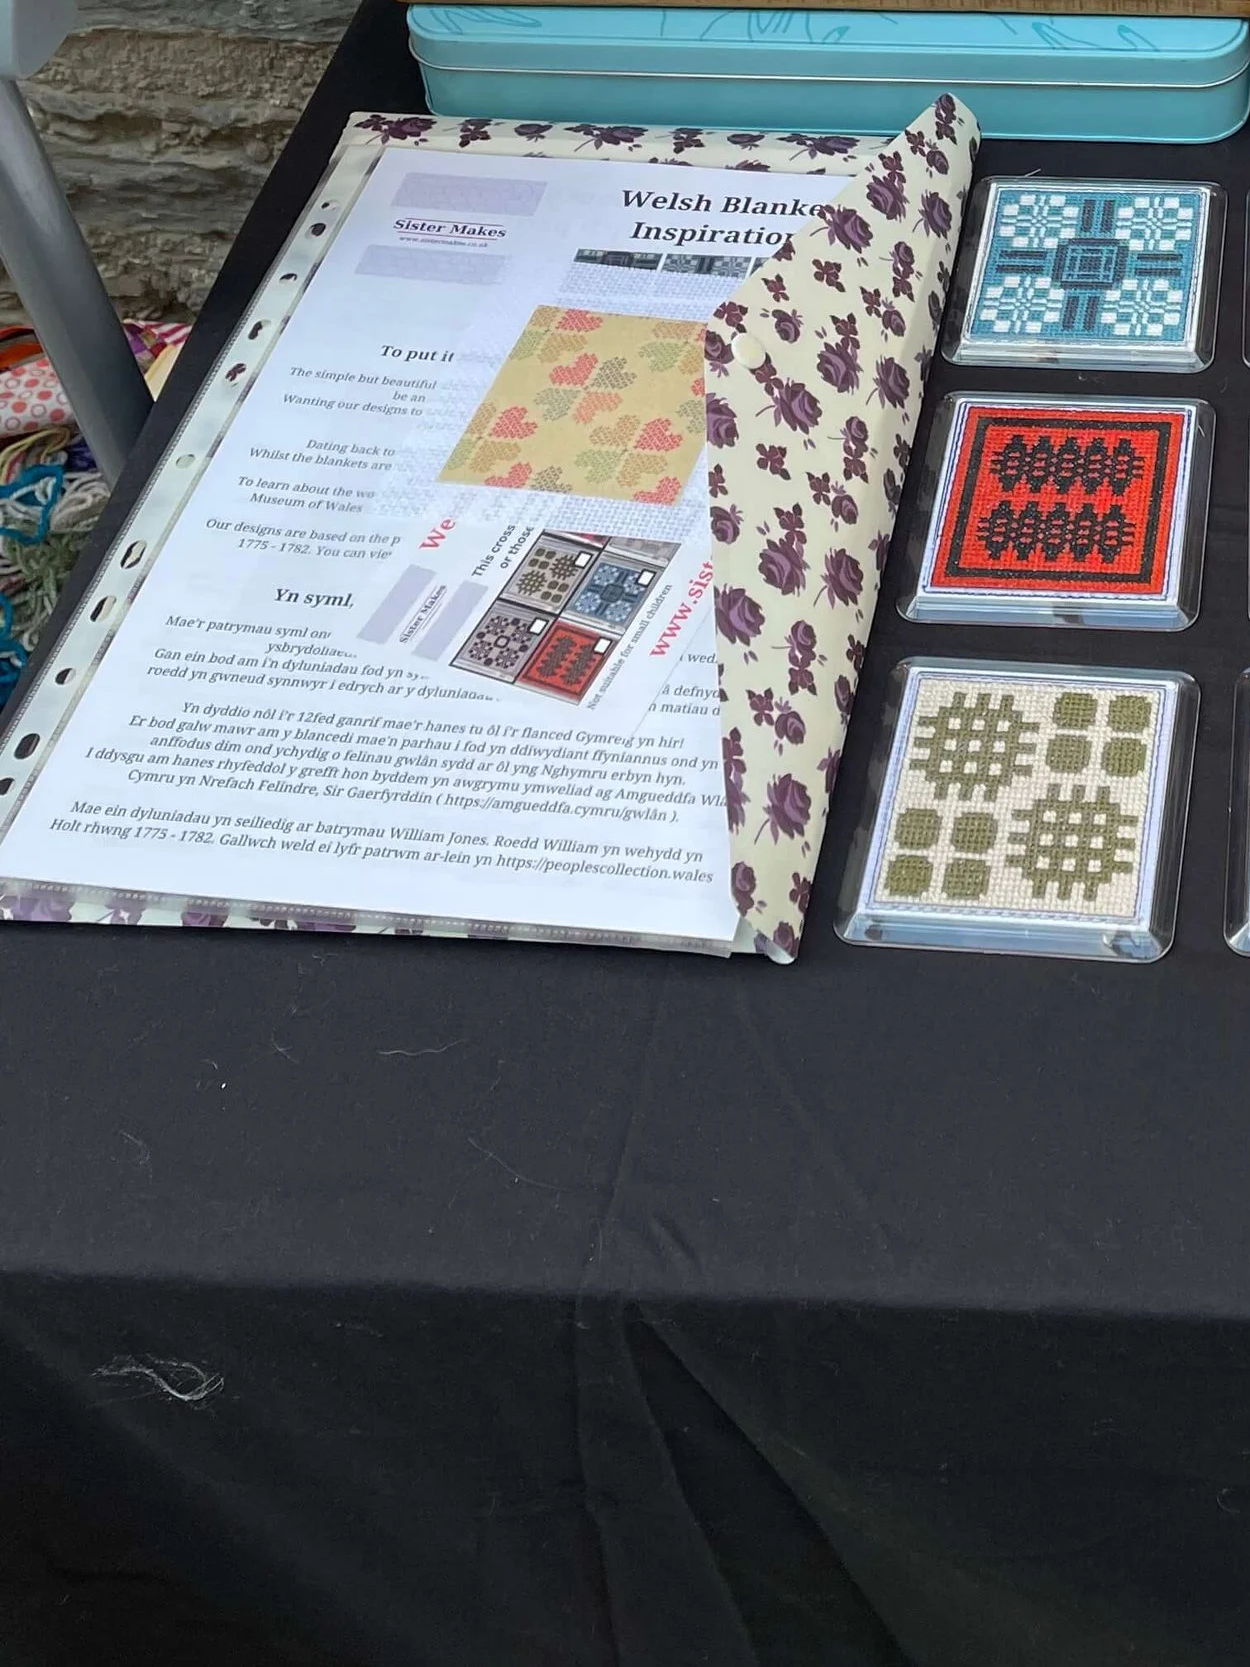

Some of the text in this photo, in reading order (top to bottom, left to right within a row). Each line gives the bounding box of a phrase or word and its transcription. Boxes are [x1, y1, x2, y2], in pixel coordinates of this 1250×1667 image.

[621, 189, 823, 216] Welsh Blanke
[393, 219, 506, 239] Sister Makes
[380, 345, 402, 358] To
[405, 350, 441, 363] put
[289, 367, 437, 390] The simple but beautiful
[206, 518, 389, 544] Our designs are based on the
[274, 588, 299, 603] Yn
[49, 818, 82, 833] Holt
[83, 821, 132, 840] rhwng
[134, 826, 168, 840] 1775
[219, 834, 276, 849] Gallwch
[280, 839, 316, 853] weld
[318, 842, 332, 853] ei
[334, 843, 361, 857] lyfr
[362, 845, 419, 860] patrwm
[475, 855, 492, 868] yn
[70, 801, 703, 863] Mae ein dyluniadau yn seiliedig ar batrymau William Jones. Roedd William yn wehydd yn
